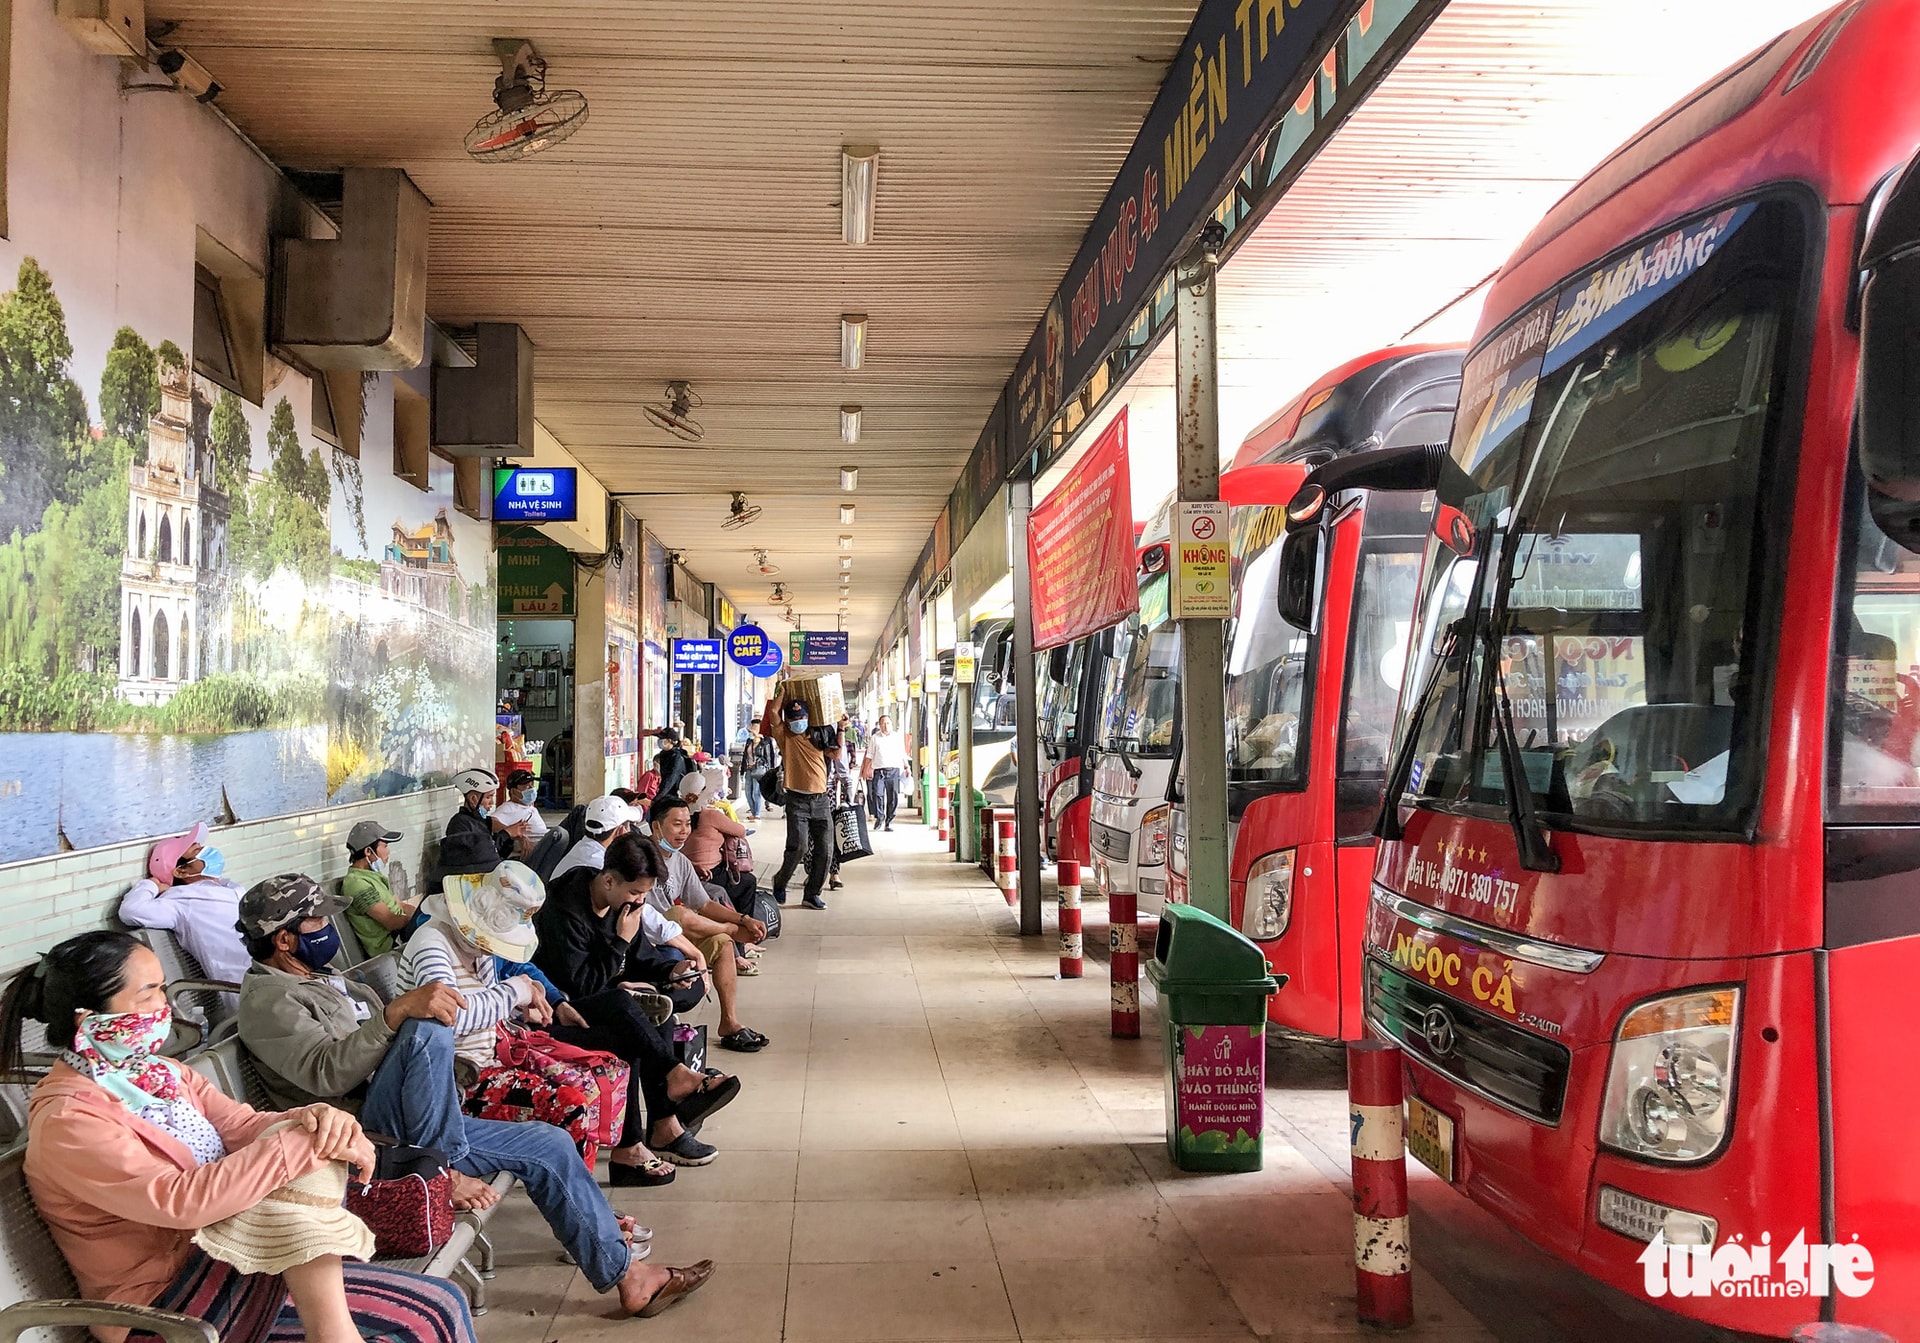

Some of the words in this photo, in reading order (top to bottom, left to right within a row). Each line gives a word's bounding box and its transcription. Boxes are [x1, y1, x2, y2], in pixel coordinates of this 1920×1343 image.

[1071, 258, 1099, 357] KHU
[1101, 196, 1137, 306] VỰC
[1164, 33, 1227, 212] MIỀN
[508, 500, 528, 510] NHÀ
[528, 500, 540, 511] VỆ
[541, 501, 562, 509] SINH
[507, 555, 540, 566] MINH
[1183, 544, 1226, 565] KHÔNG
[551, 602, 558, 612] 2
[733, 635, 762, 645] GUTA
[734, 646, 762, 657] CAFE
[792, 647, 800, 662] 3
[1469, 872, 1492, 905] 380
[1493, 879, 1520, 914] 757
[1394, 933, 1461, 986] NGỌC
[1471, 959, 1516, 1014] CẢ
[1187, 1064, 1211, 1077] HÃY
[1215, 1063, 1232, 1077] BỎ
[1186, 1082, 1212, 1094] VÀO
